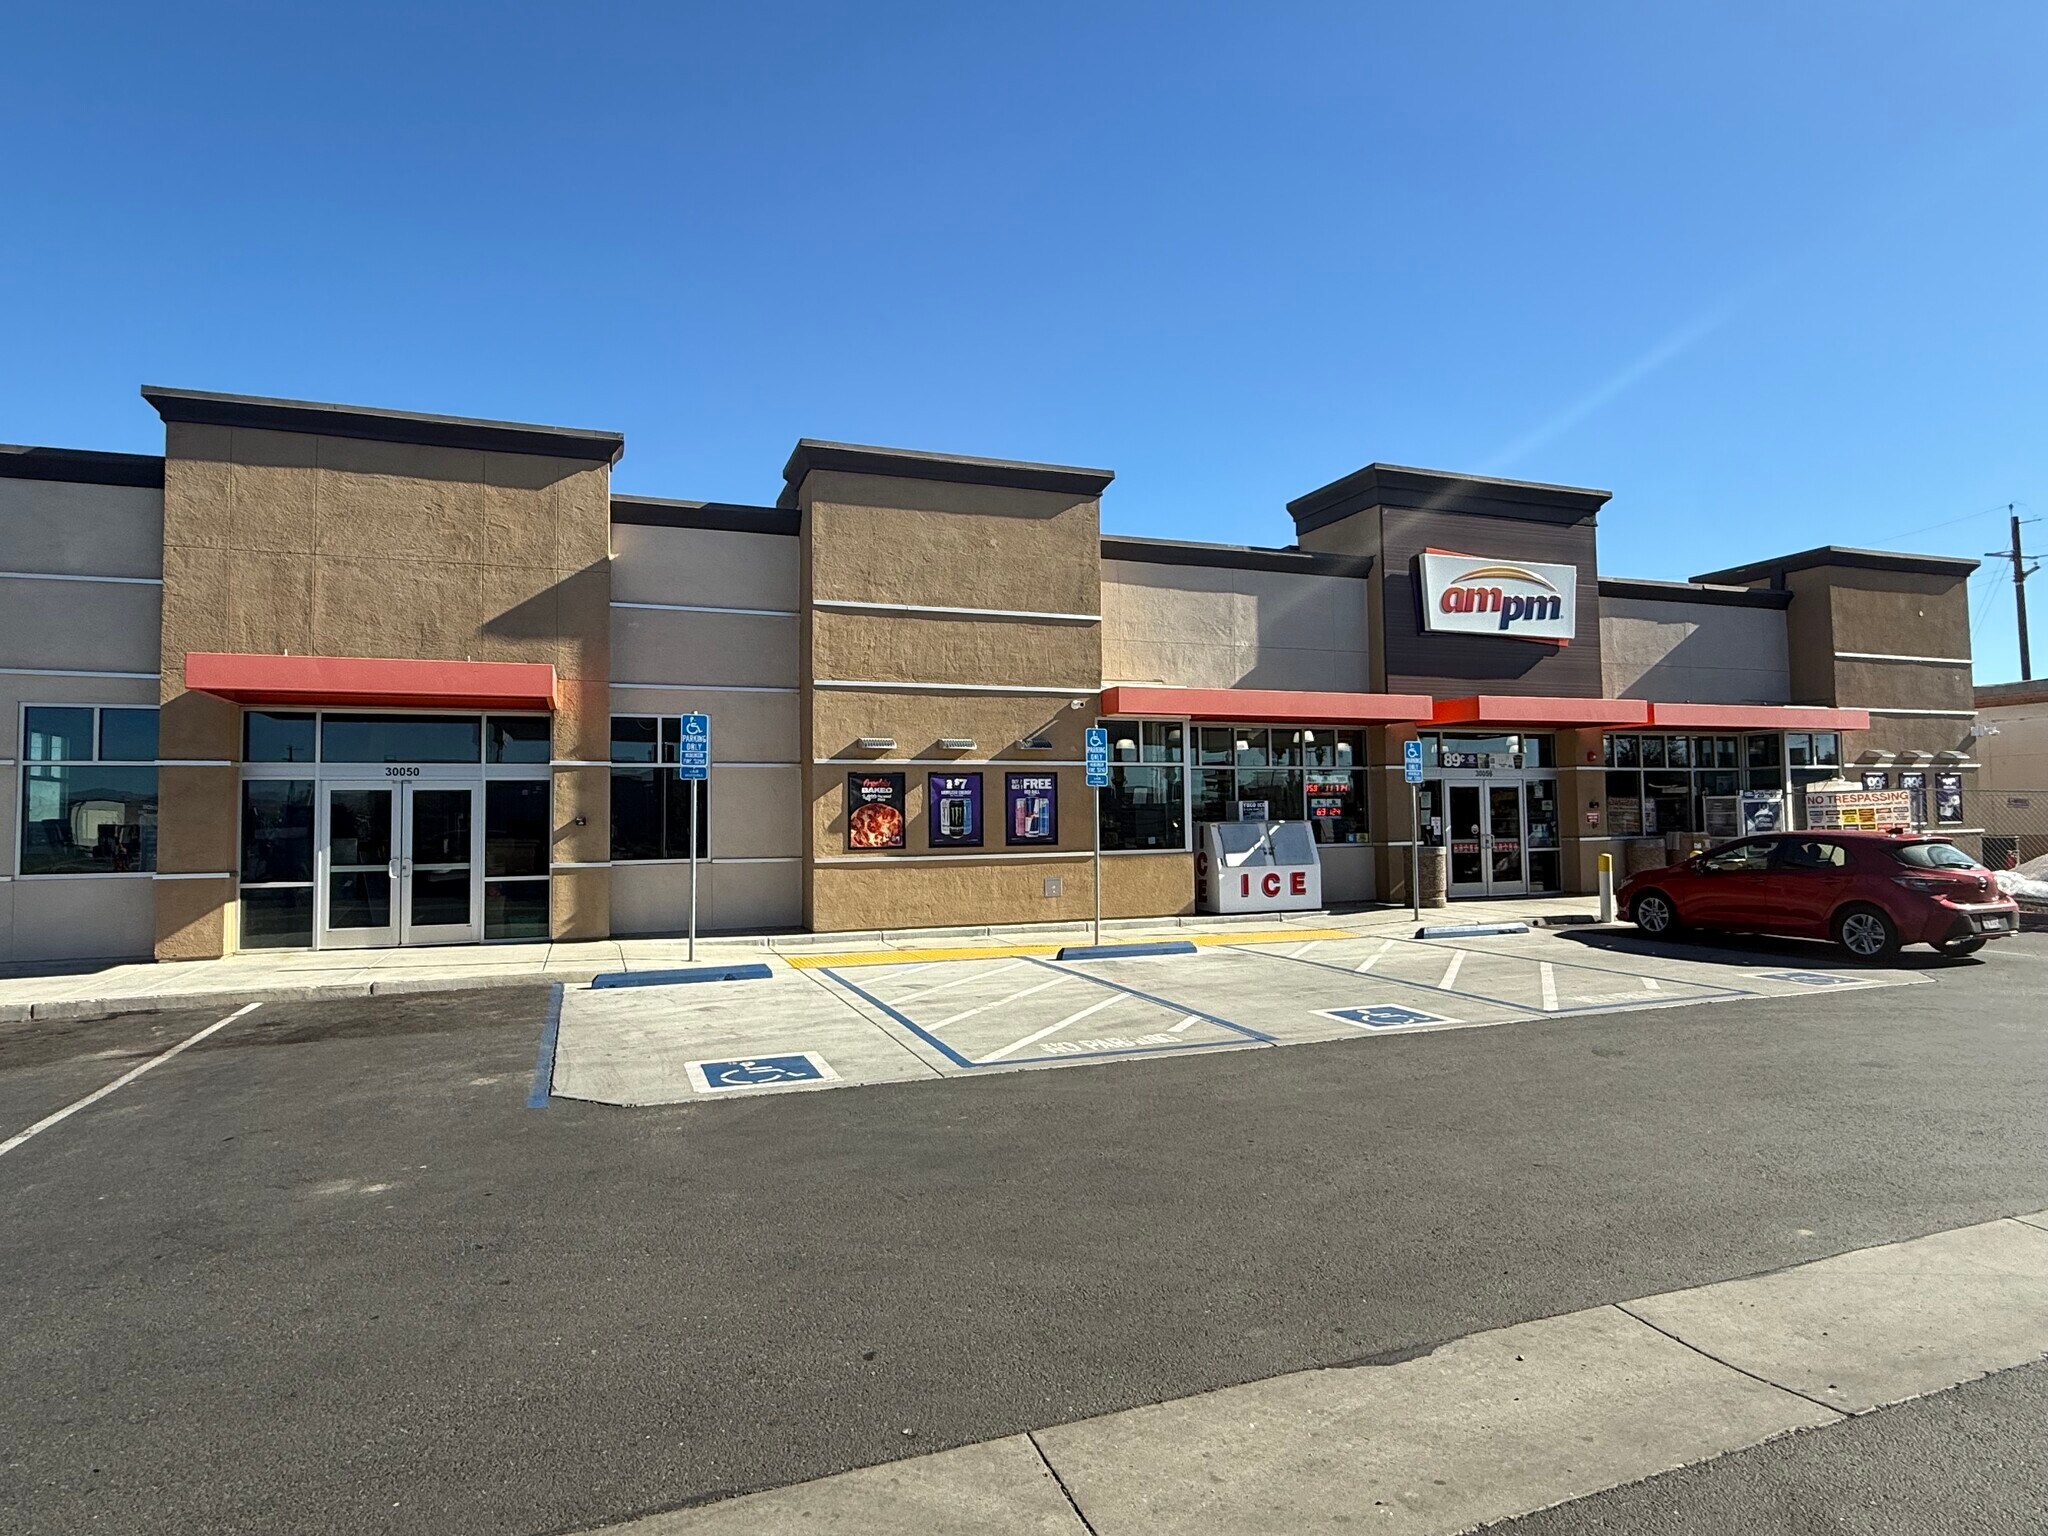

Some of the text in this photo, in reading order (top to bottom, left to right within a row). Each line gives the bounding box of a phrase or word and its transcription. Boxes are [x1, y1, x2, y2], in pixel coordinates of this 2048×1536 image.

[1441, 586, 1562, 631] ampm
[686, 743, 702, 751] ONLY
[385, 767, 420, 776] 30050
[1023, 779, 1053, 790] FREE
[1807, 796, 1824, 805] NO
[1826, 791, 1909, 804] TRESPASSING
[1241, 872, 1306, 897] ICE
[1038, 1033, 1183, 1054] NO PARKING
